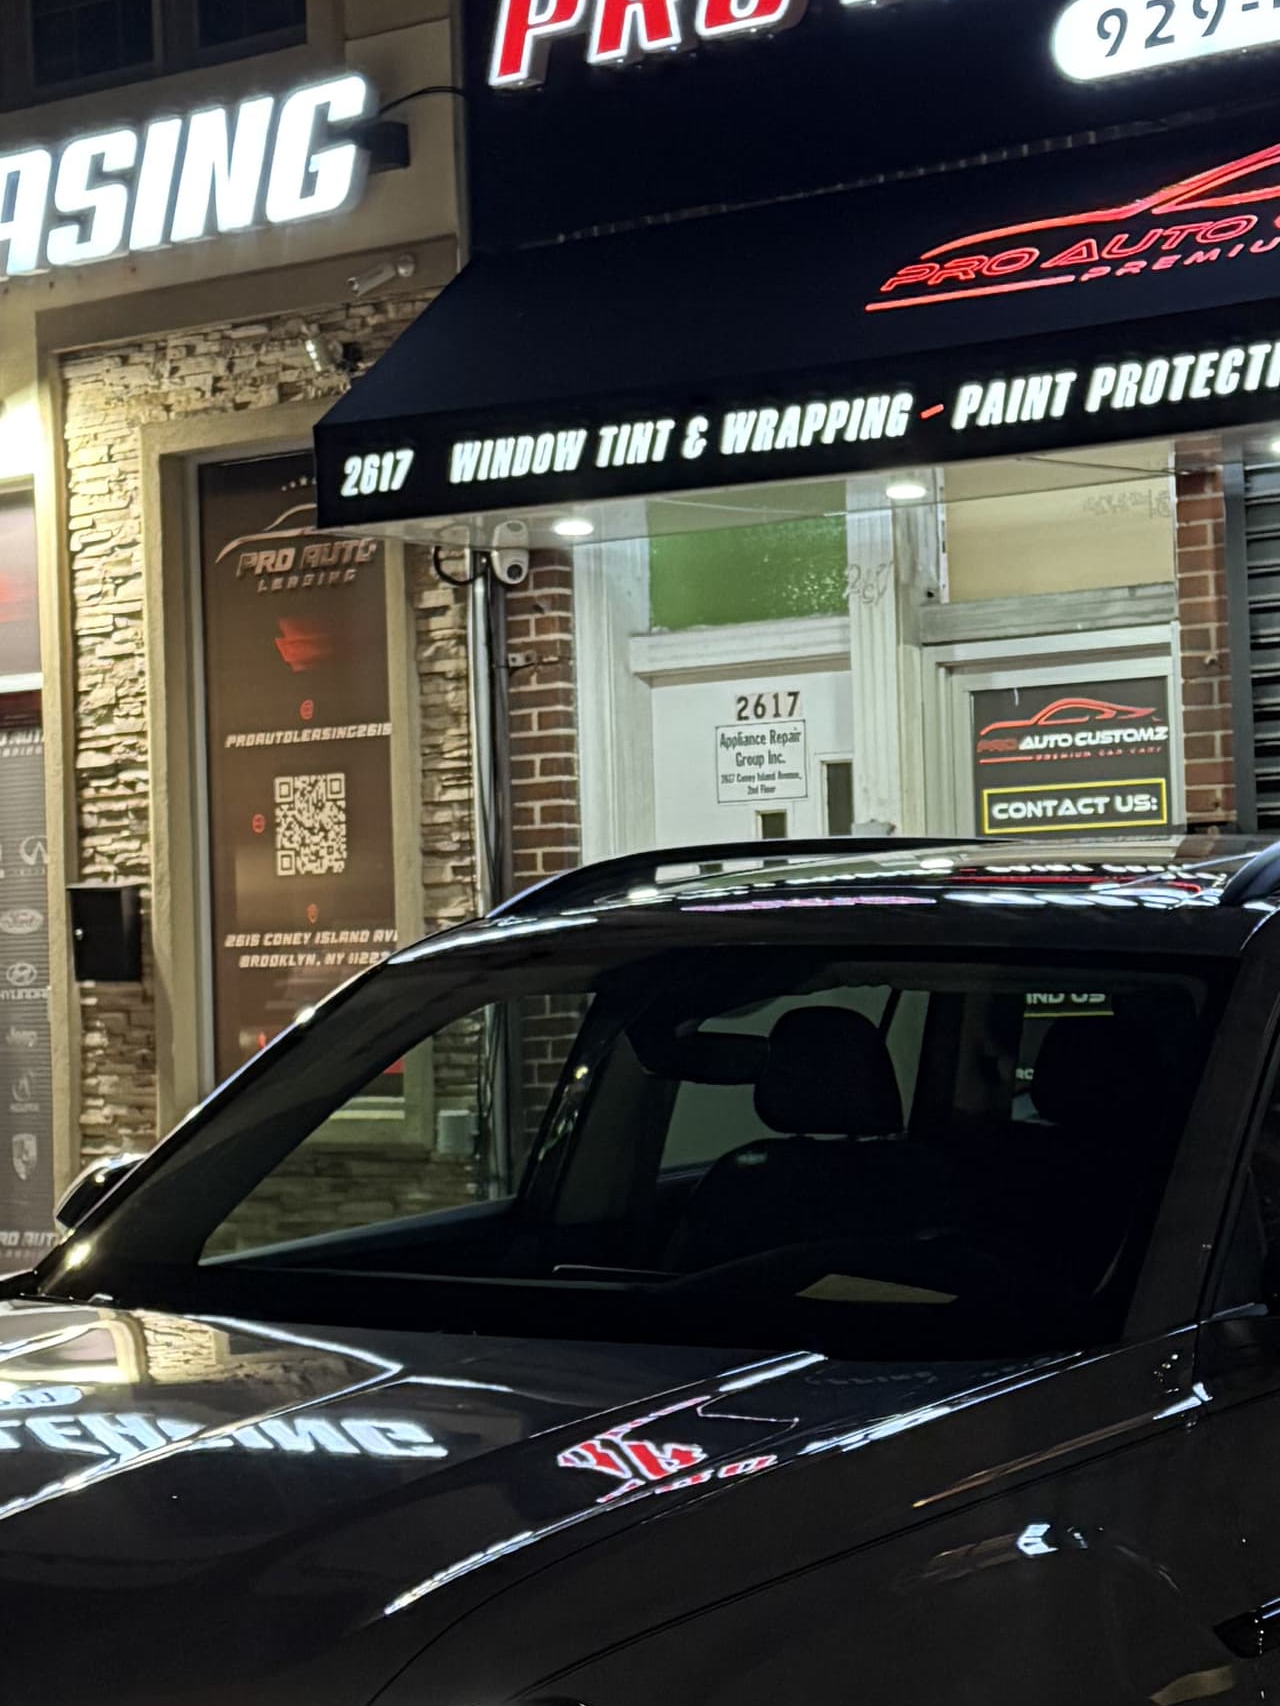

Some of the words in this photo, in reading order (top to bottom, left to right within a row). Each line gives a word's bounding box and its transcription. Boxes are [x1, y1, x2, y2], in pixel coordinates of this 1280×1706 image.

[879, 244, 1040, 295] PRO
[1039, 213, 1258, 272] AUTO
[339, 447, 416, 498] 2617
[448, 426, 589, 485] WINDOW
[594, 417, 677, 470] TINT
[681, 413, 710, 461] &
[720, 390, 915, 457] WRAPPING
[949, 366, 1077, 433] PAINT
[235, 546, 296, 578] PRO
[299, 535, 378, 570] AUTO
[256, 568, 358, 593] LEASING
[735, 690, 801, 722] 2617
[720, 730, 767, 750] Appliance
[768, 727, 802, 747] Repair
[1018, 732, 1074, 751] AUTO
[1074, 726, 1169, 748] CUSTOMZ
[735, 751, 765, 769] Group
[992, 796, 1110, 822] CONTACT
[1115, 793, 1158, 815] US:
